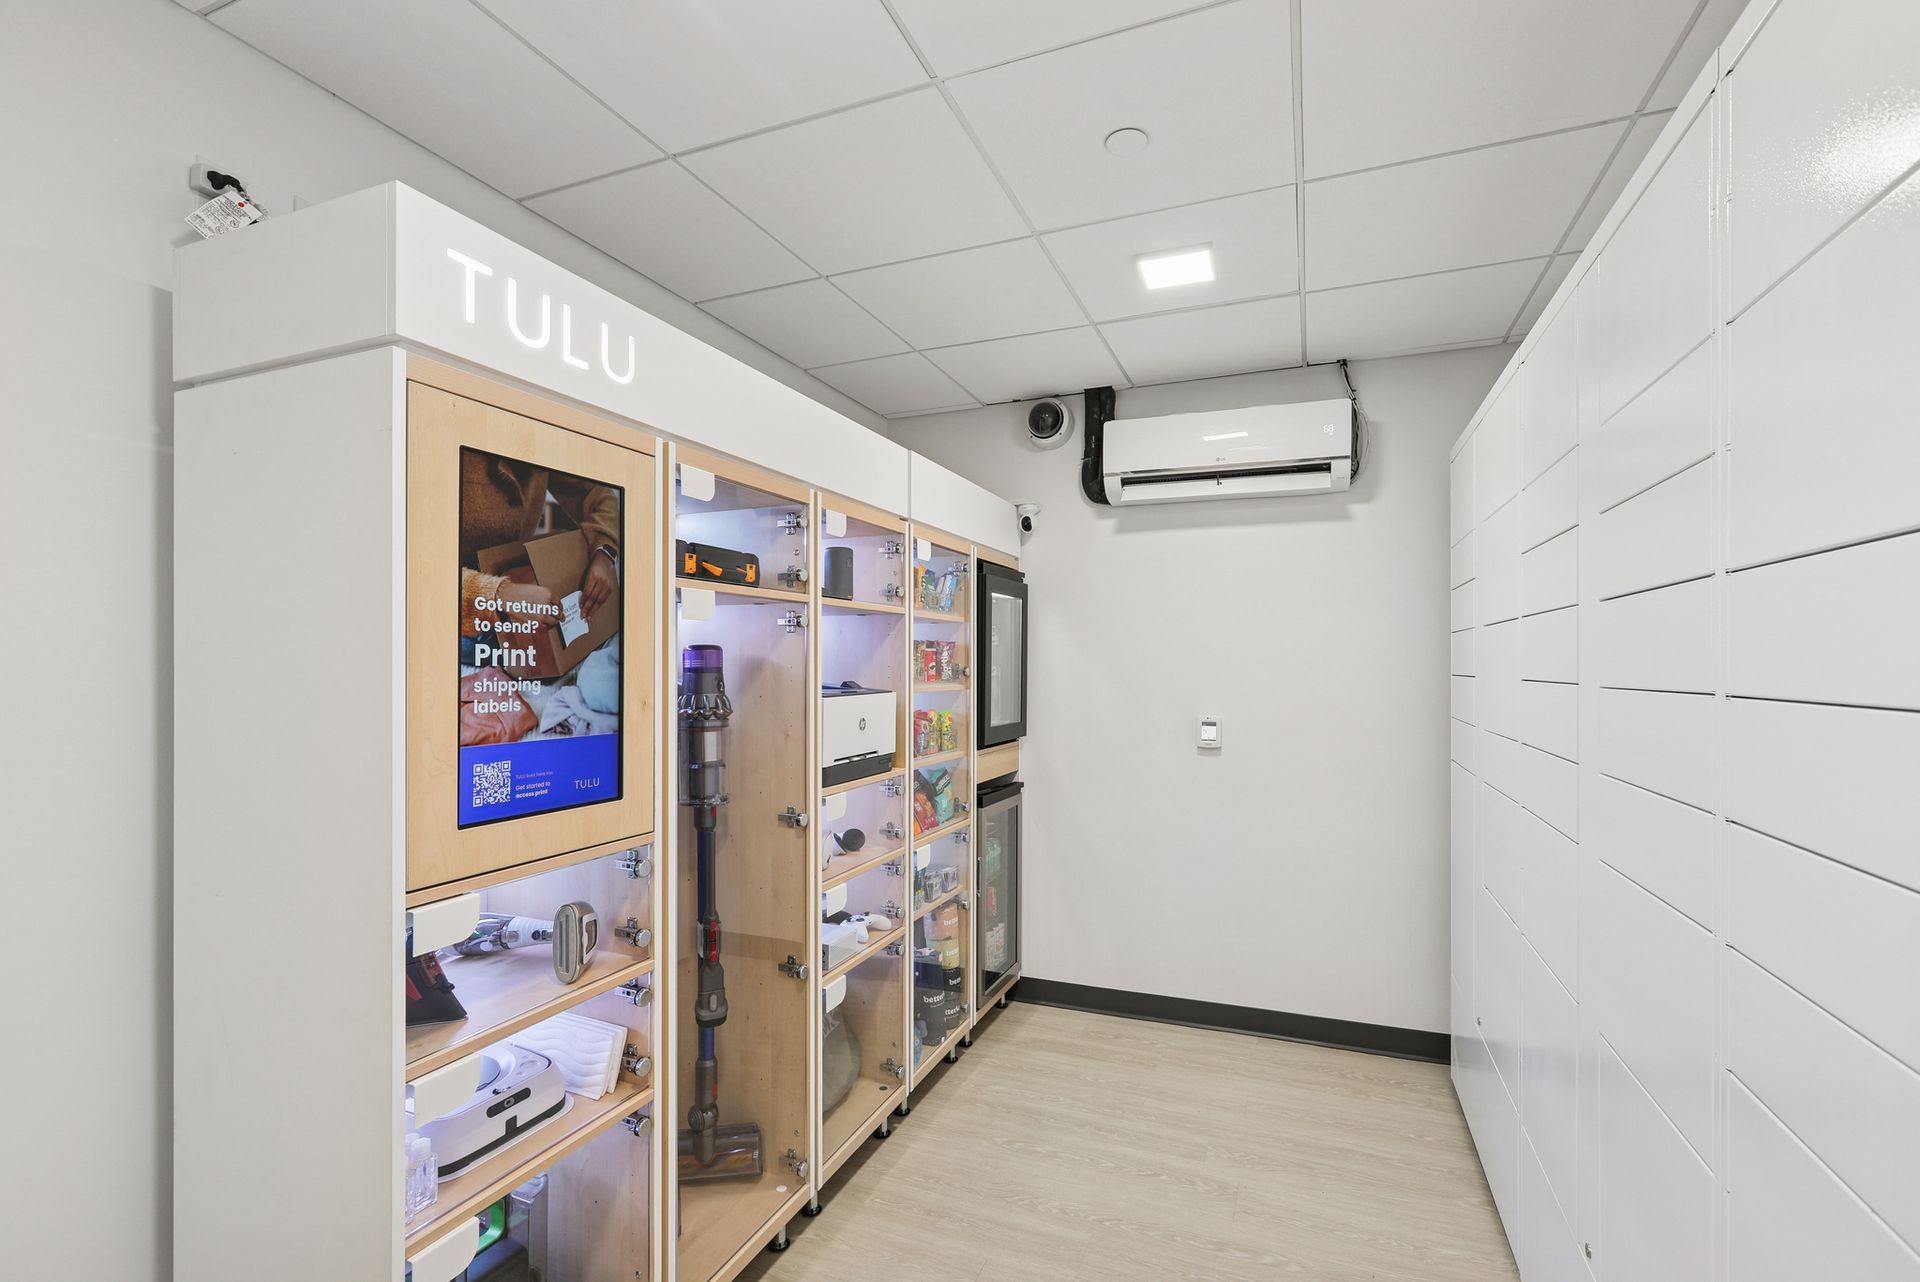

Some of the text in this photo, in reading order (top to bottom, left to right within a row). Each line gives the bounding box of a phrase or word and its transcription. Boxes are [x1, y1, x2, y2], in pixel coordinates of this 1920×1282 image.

[447, 247, 635, 384] TULU
[474, 597, 503, 612] Got
[506, 600, 559, 616] returns
[474, 618, 539, 634] to send?
[474, 642, 537, 667] Print
[473, 677, 541, 696] shipping
[473, 698, 521, 714] labels
[574, 777, 600, 790] TULU
